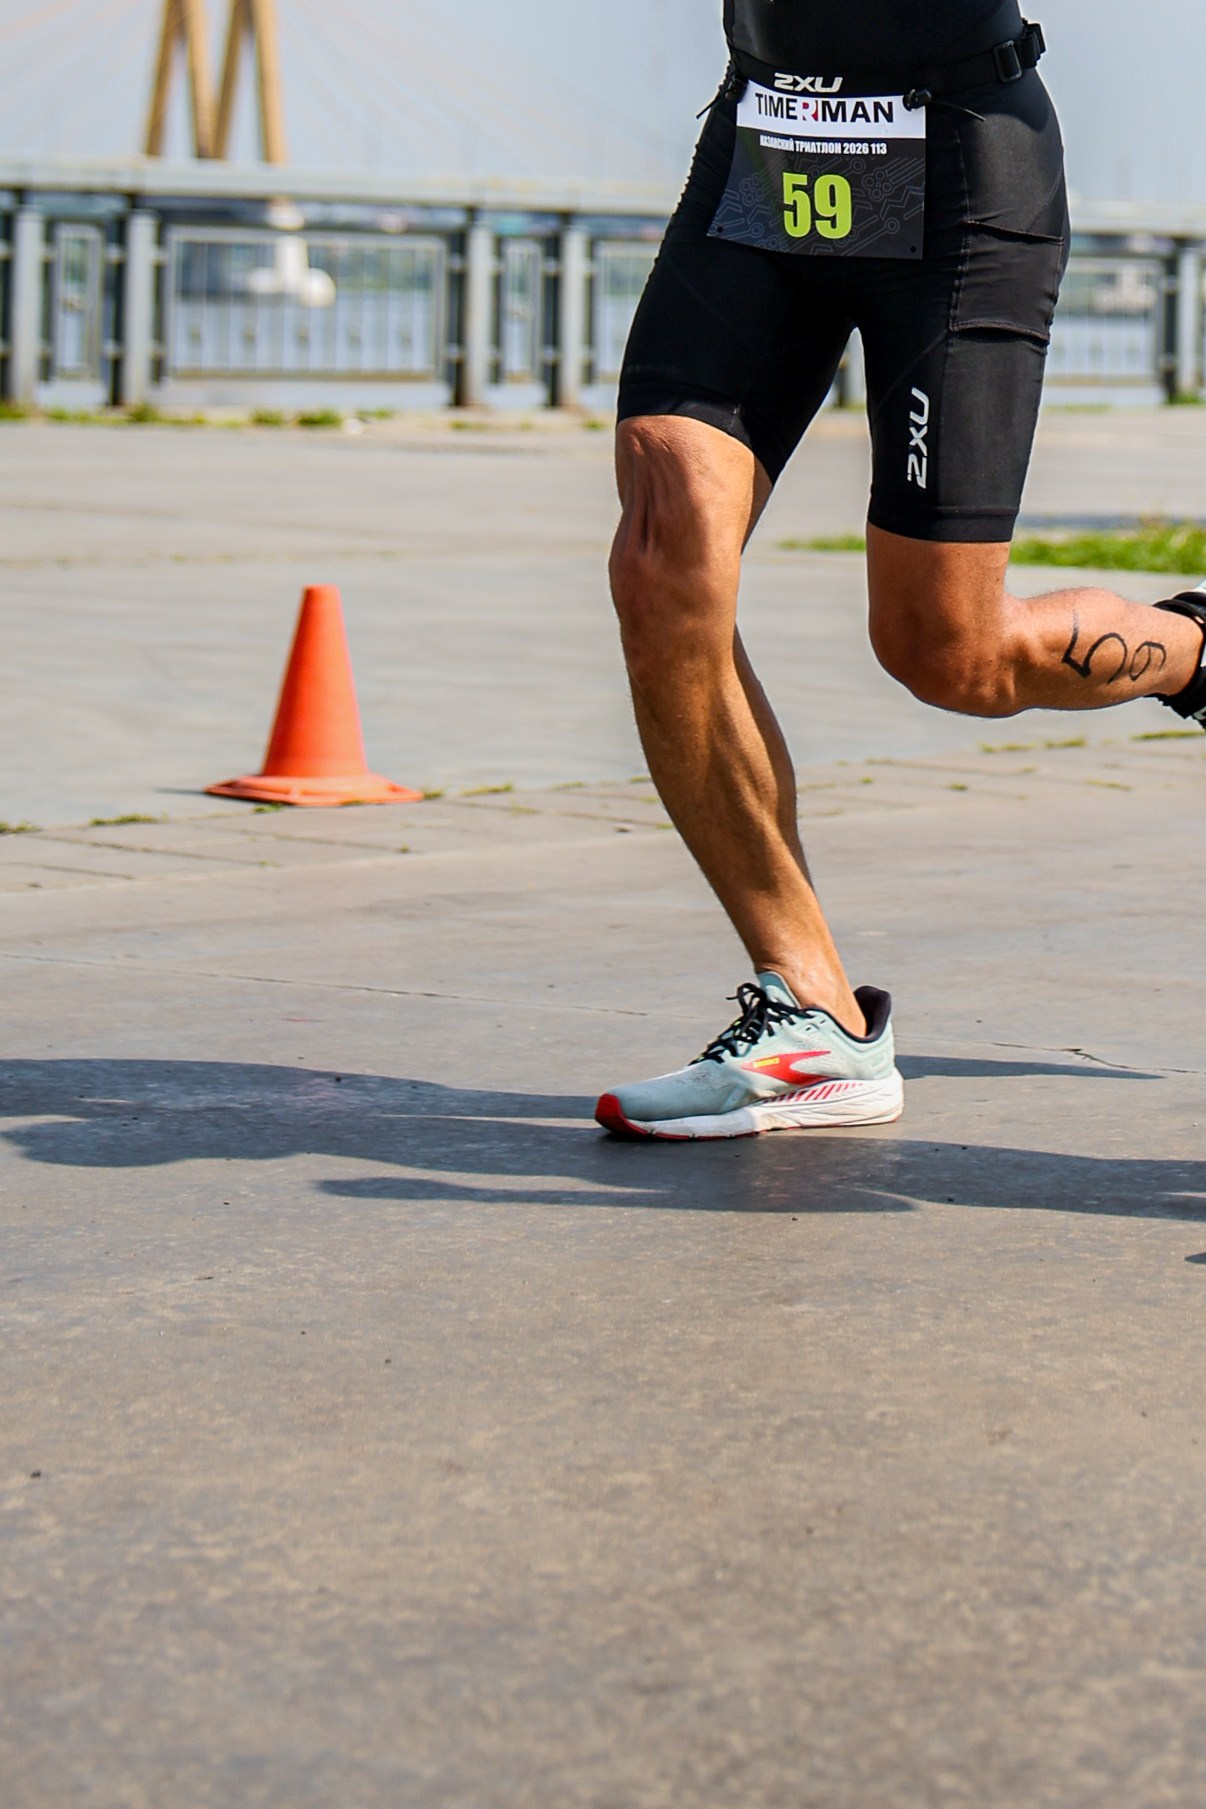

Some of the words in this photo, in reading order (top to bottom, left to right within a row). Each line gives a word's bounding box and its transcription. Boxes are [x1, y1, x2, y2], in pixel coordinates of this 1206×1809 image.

[773, 72, 844, 93] 2XU
[795, 140, 842, 155] ТРИАТЛОН
[842, 142, 869, 155] 2026
[870, 142, 888, 155] 113
[782, 171, 852, 240] 59
[907, 386, 930, 489] 2XU
